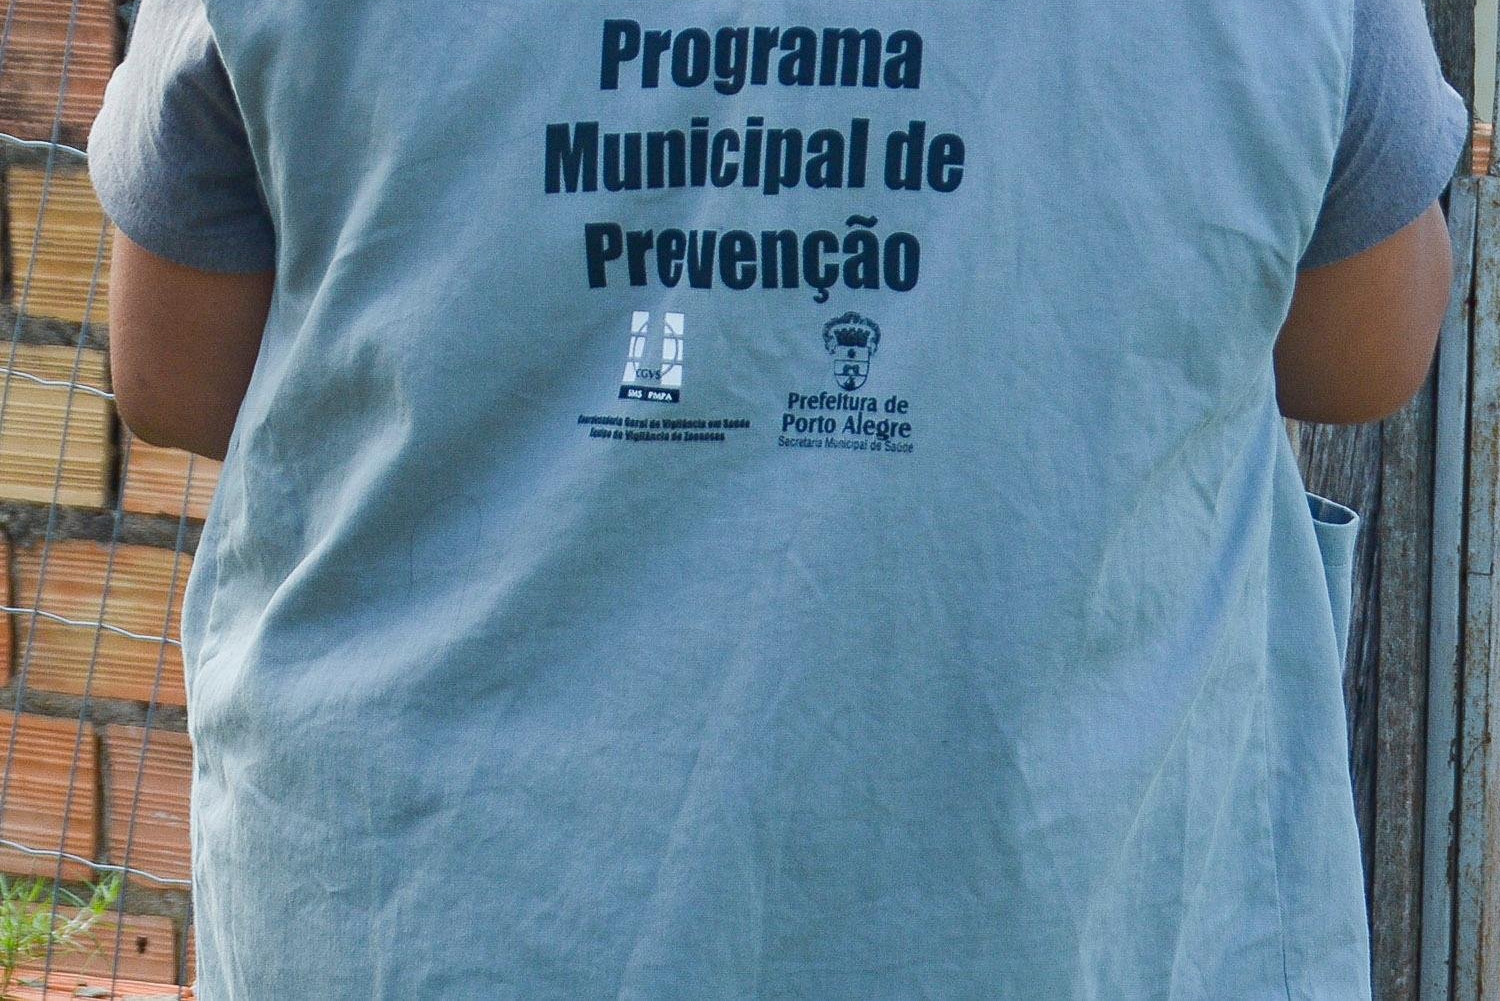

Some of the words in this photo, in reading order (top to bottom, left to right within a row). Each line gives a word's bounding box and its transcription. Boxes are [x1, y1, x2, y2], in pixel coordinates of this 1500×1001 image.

[600, 19, 923, 95] Programa
[545, 116, 870, 196] Municipal
[884, 120, 965, 193] de
[584, 214, 920, 304] Prevenção
[782, 412, 836, 434] Porto
[842, 411, 912, 440] Alegre
[788, 391, 877, 412] Prefeitura
[884, 395, 909, 414] de
